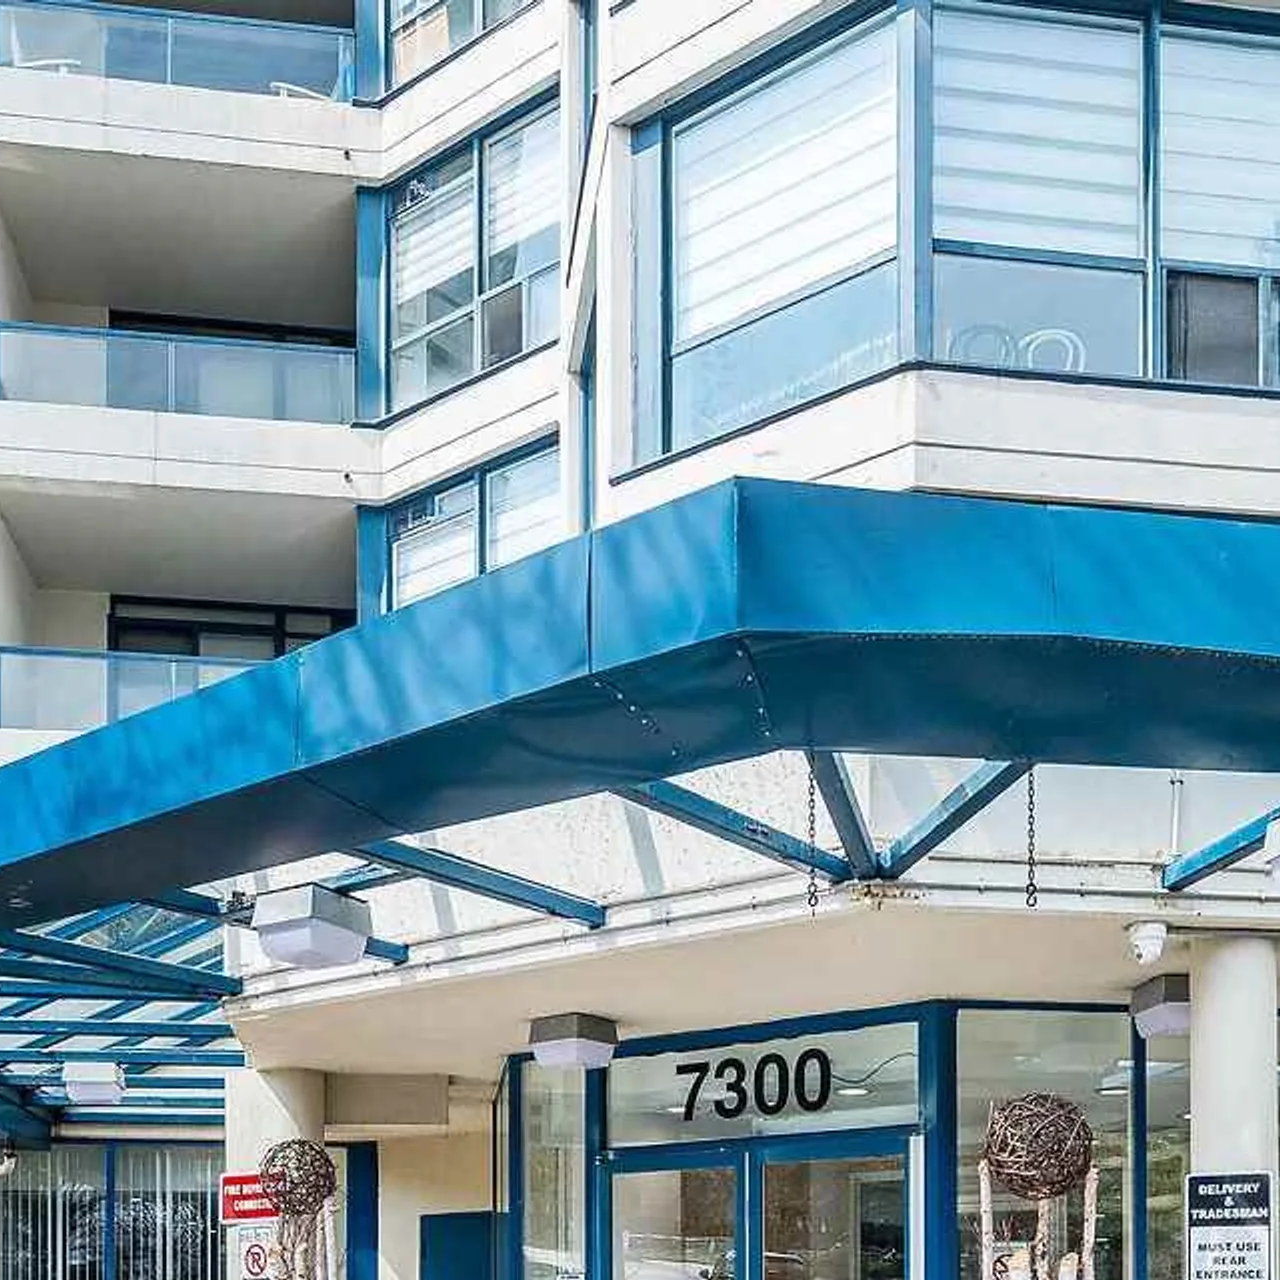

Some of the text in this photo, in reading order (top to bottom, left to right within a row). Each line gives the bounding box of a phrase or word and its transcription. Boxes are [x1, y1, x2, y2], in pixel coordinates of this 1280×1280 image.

[676, 1048, 832, 1121] 7300
[1198, 1182, 1260, 1195] DELIVERY
[1190, 1207, 1269, 1220] TRADESMAN
[1197, 1242, 1261, 1251] MUST USE
[1213, 1256, 1247, 1265] REAR
[1196, 1270, 1262, 1279] ENTRANCE
